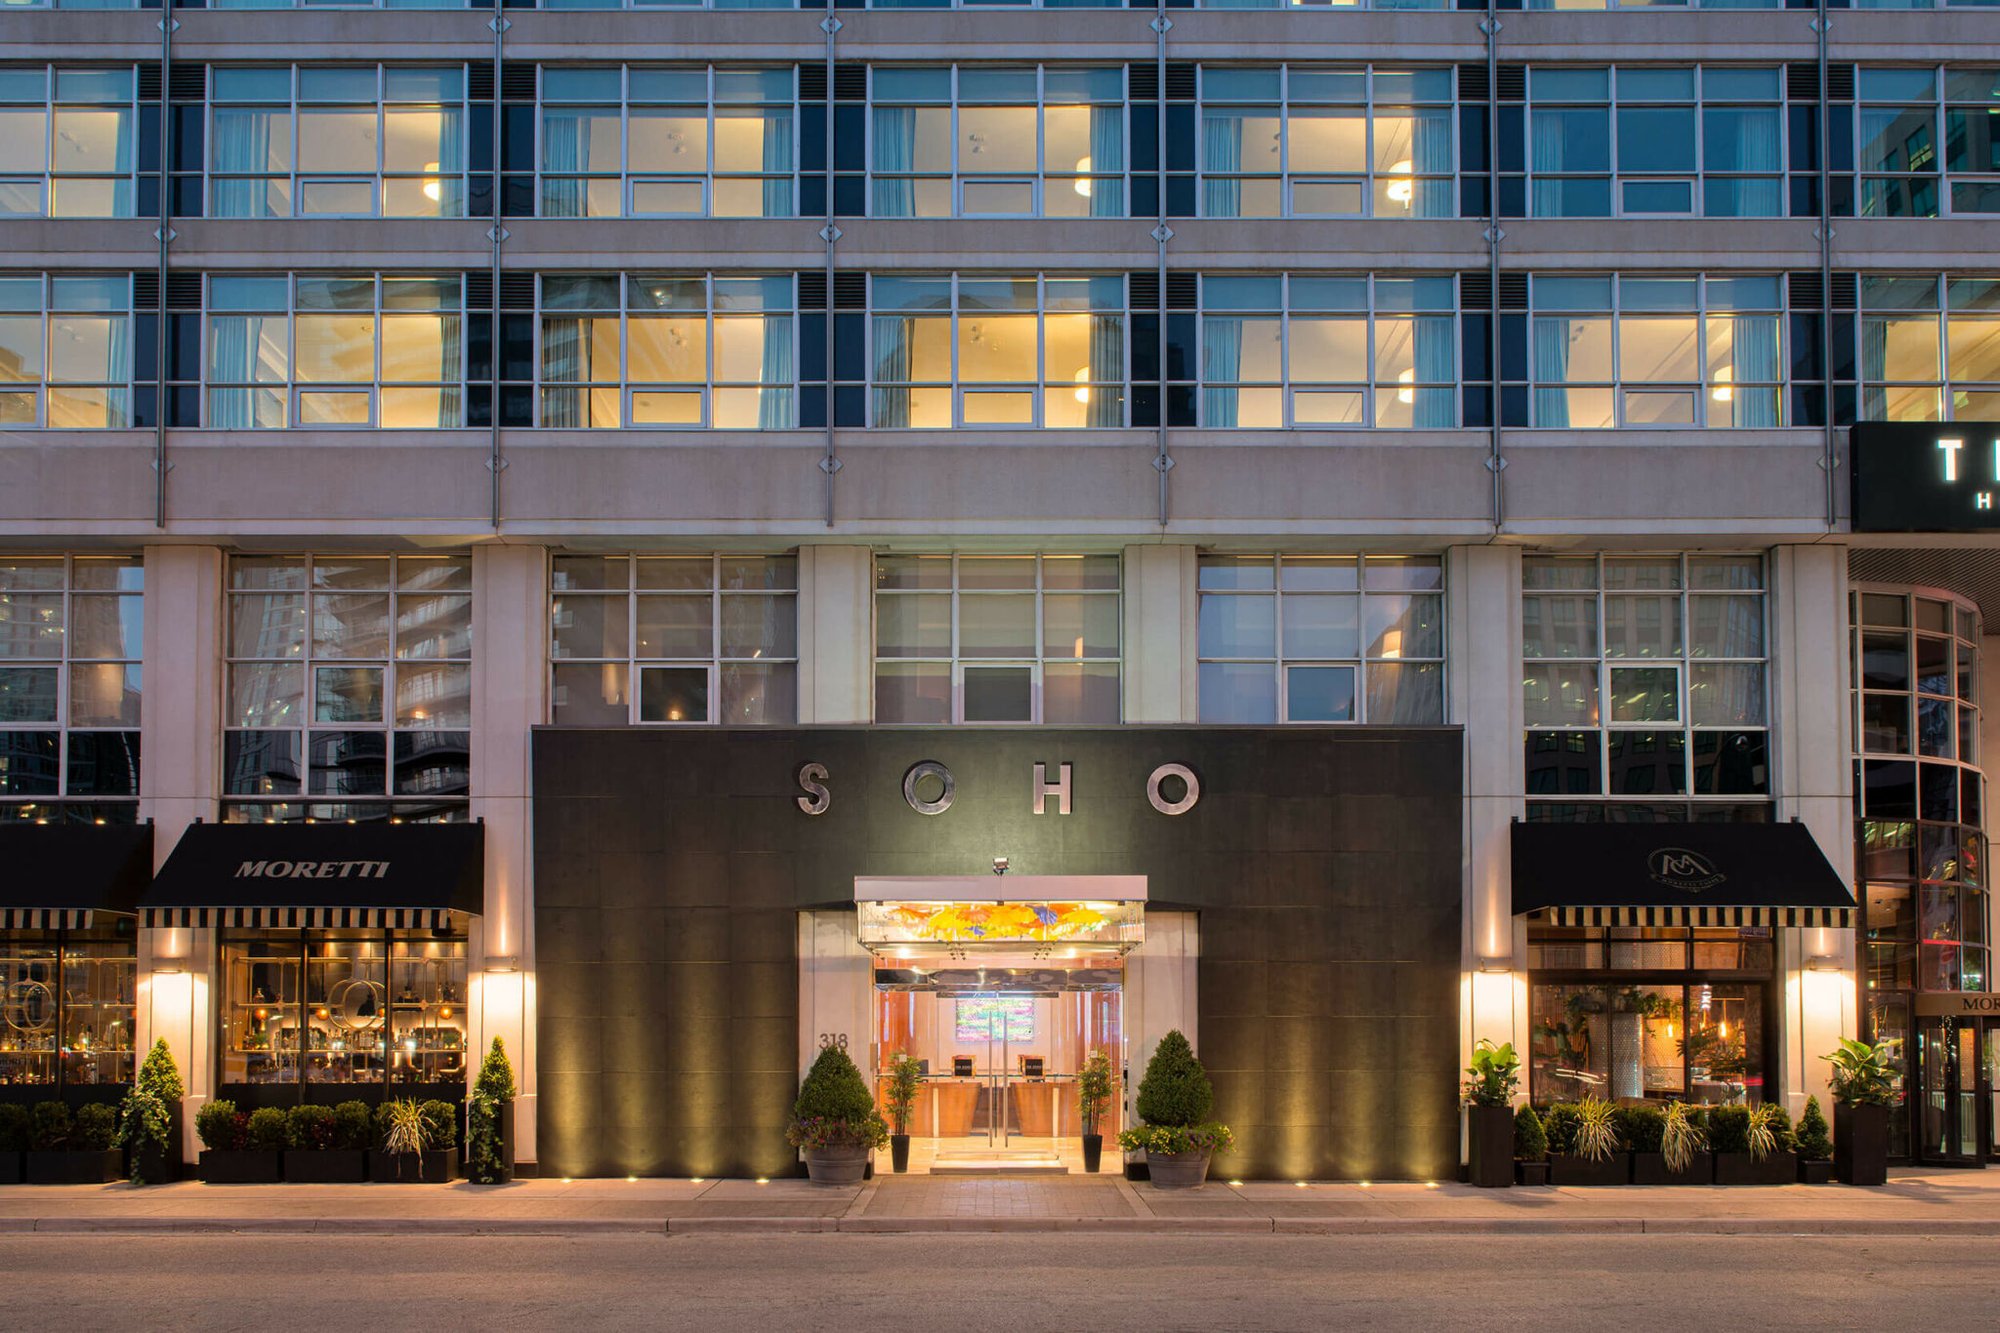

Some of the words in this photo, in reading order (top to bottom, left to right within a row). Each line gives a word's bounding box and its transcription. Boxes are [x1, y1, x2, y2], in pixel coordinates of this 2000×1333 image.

[1937, 438, 2000, 482] T
[797, 762, 1200, 816] SOHO
[234, 860, 391, 879] MORETTI
[818, 1033, 848, 1050] 318
